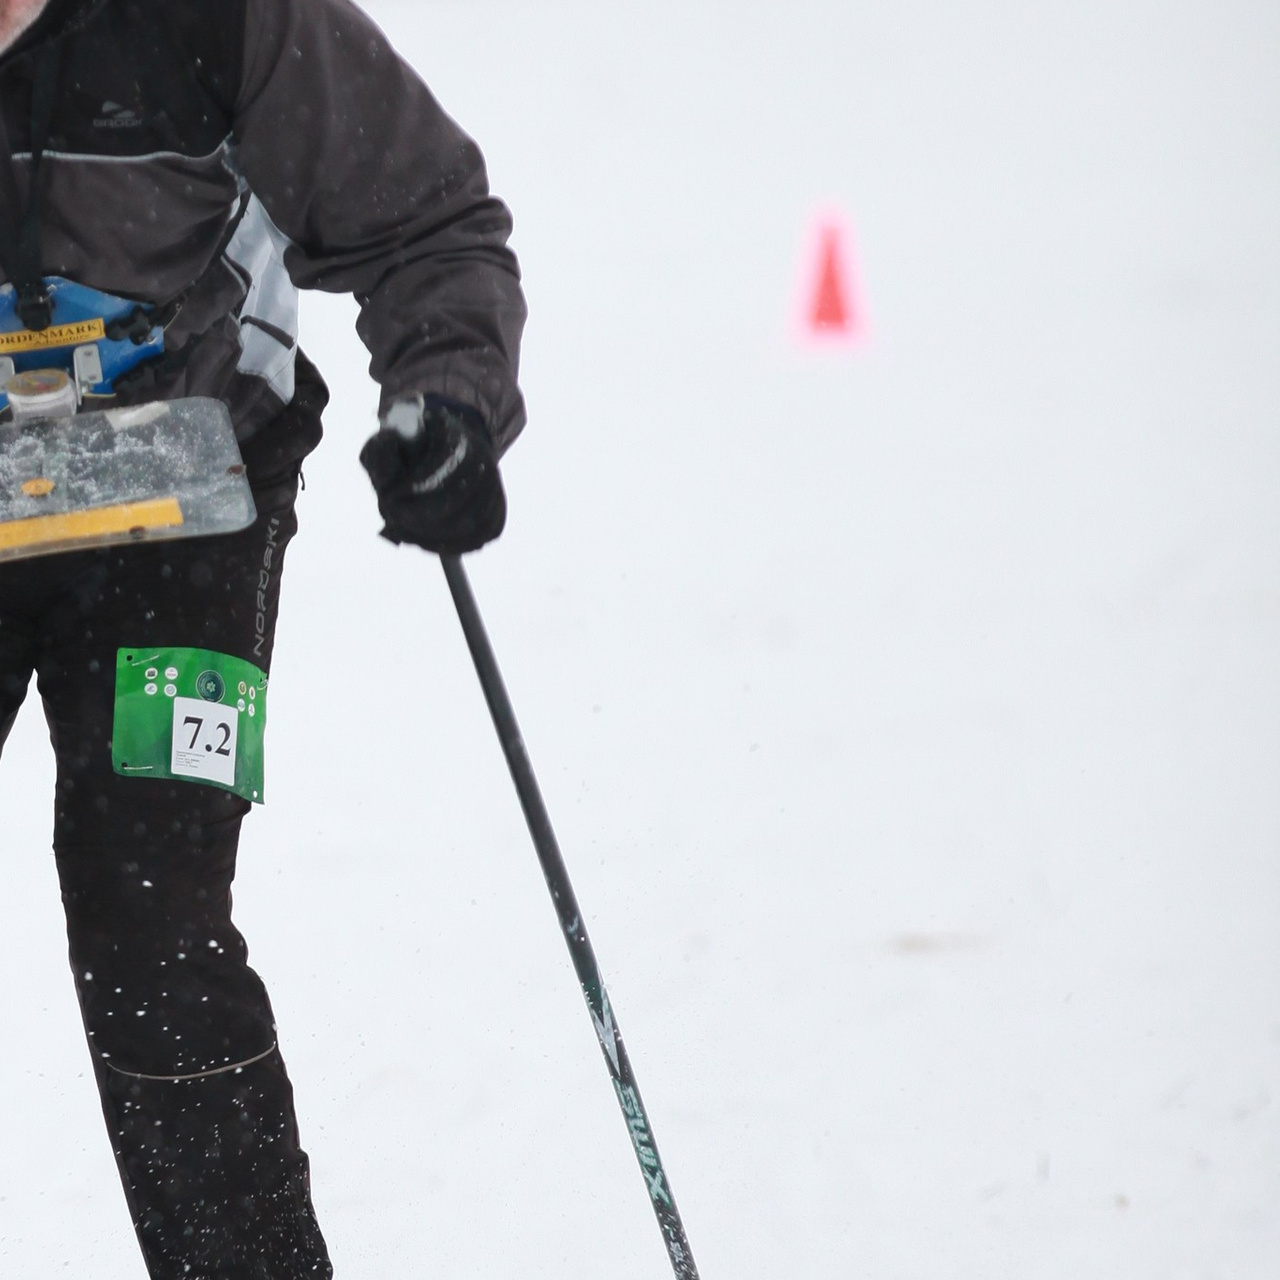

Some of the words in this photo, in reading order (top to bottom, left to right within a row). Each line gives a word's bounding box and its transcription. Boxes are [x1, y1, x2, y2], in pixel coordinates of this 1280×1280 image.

[253, 517, 281, 657] NORDSKI
[182, 715, 231, 757] 7.2
[614, 1077, 671, 1202] SWIX
